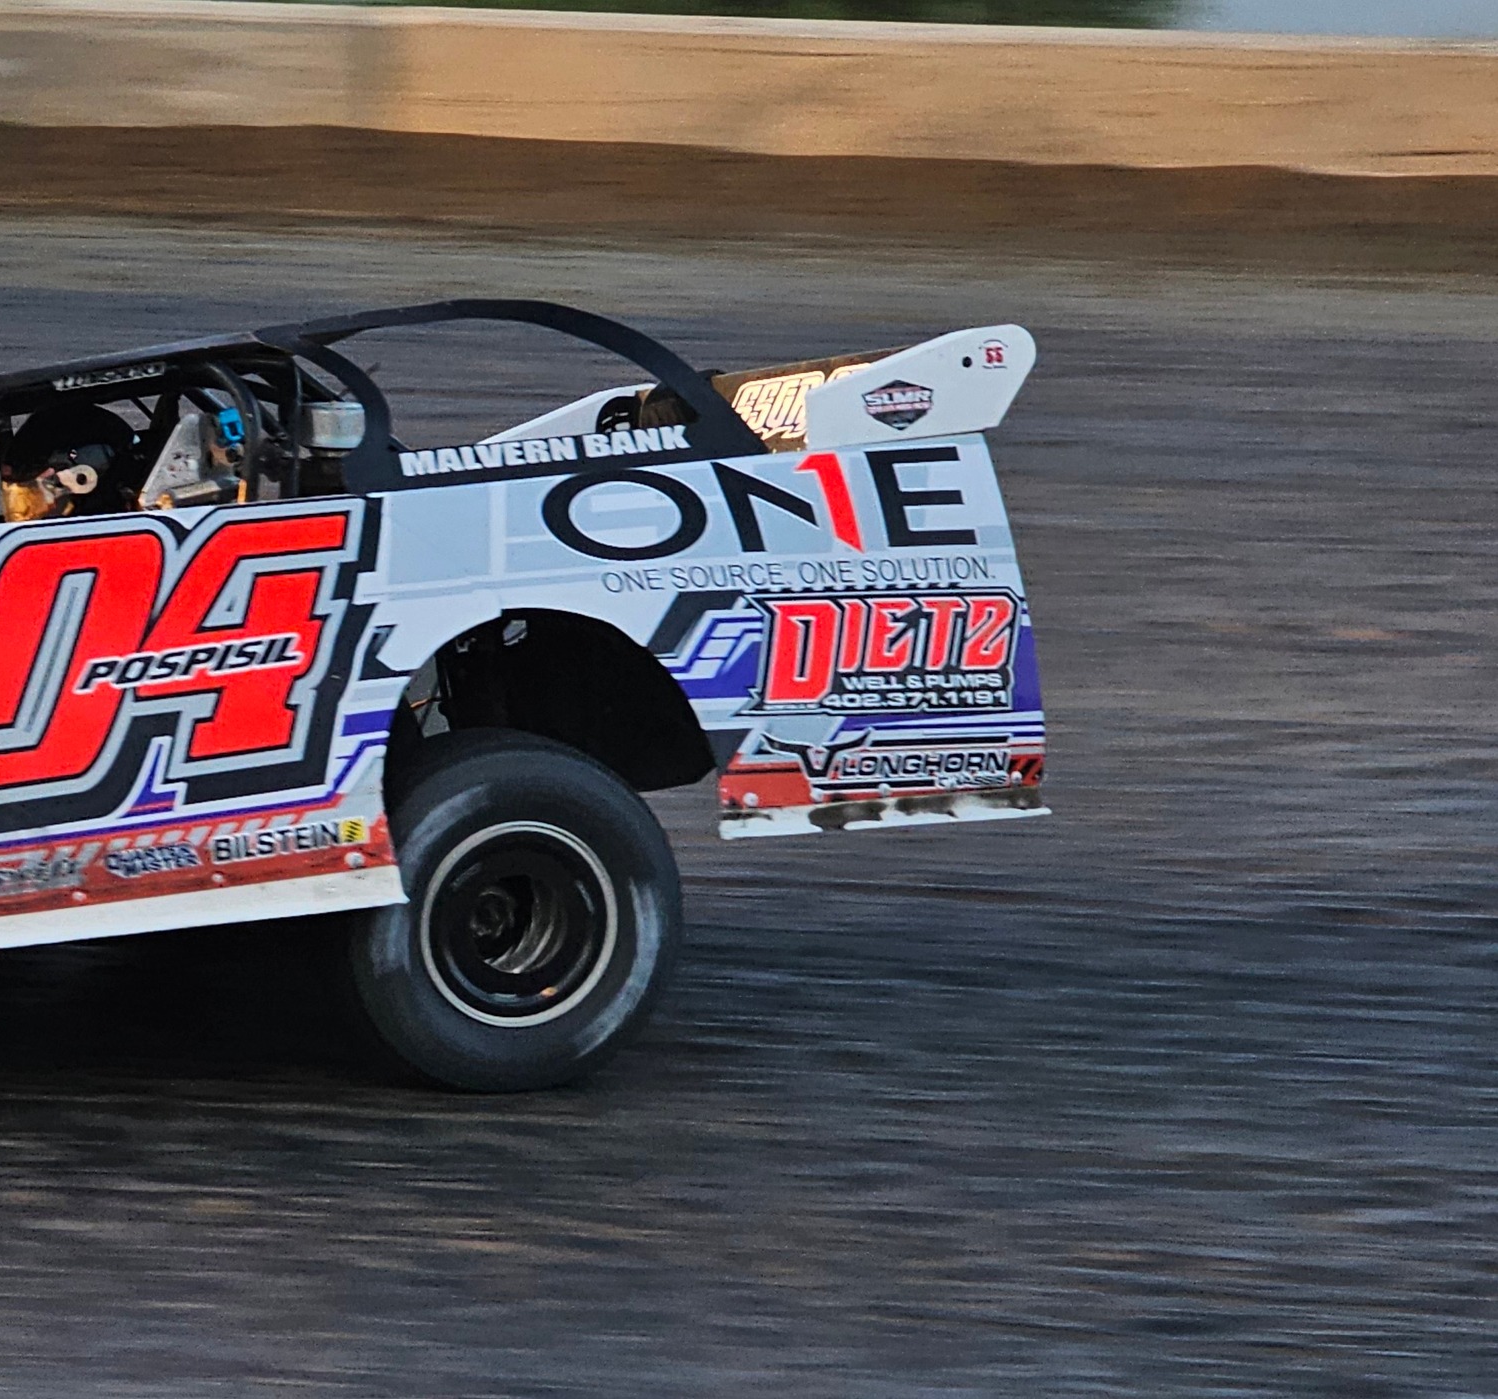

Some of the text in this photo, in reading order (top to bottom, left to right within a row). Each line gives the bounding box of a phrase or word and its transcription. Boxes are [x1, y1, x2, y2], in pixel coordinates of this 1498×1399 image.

[399, 425, 692, 476] MALVERN BANK
[603, 556, 996, 593] ONE SOURCE. ONE SOLUTION.
[80, 636, 302, 692] POSPISIL
[842, 673, 1002, 690] WELL & PUMPS
[823, 691, 1008, 708] 402.371.1191
[842, 752, 1009, 778] LONGHORN
[213, 822, 342, 862] BILSTEIN
